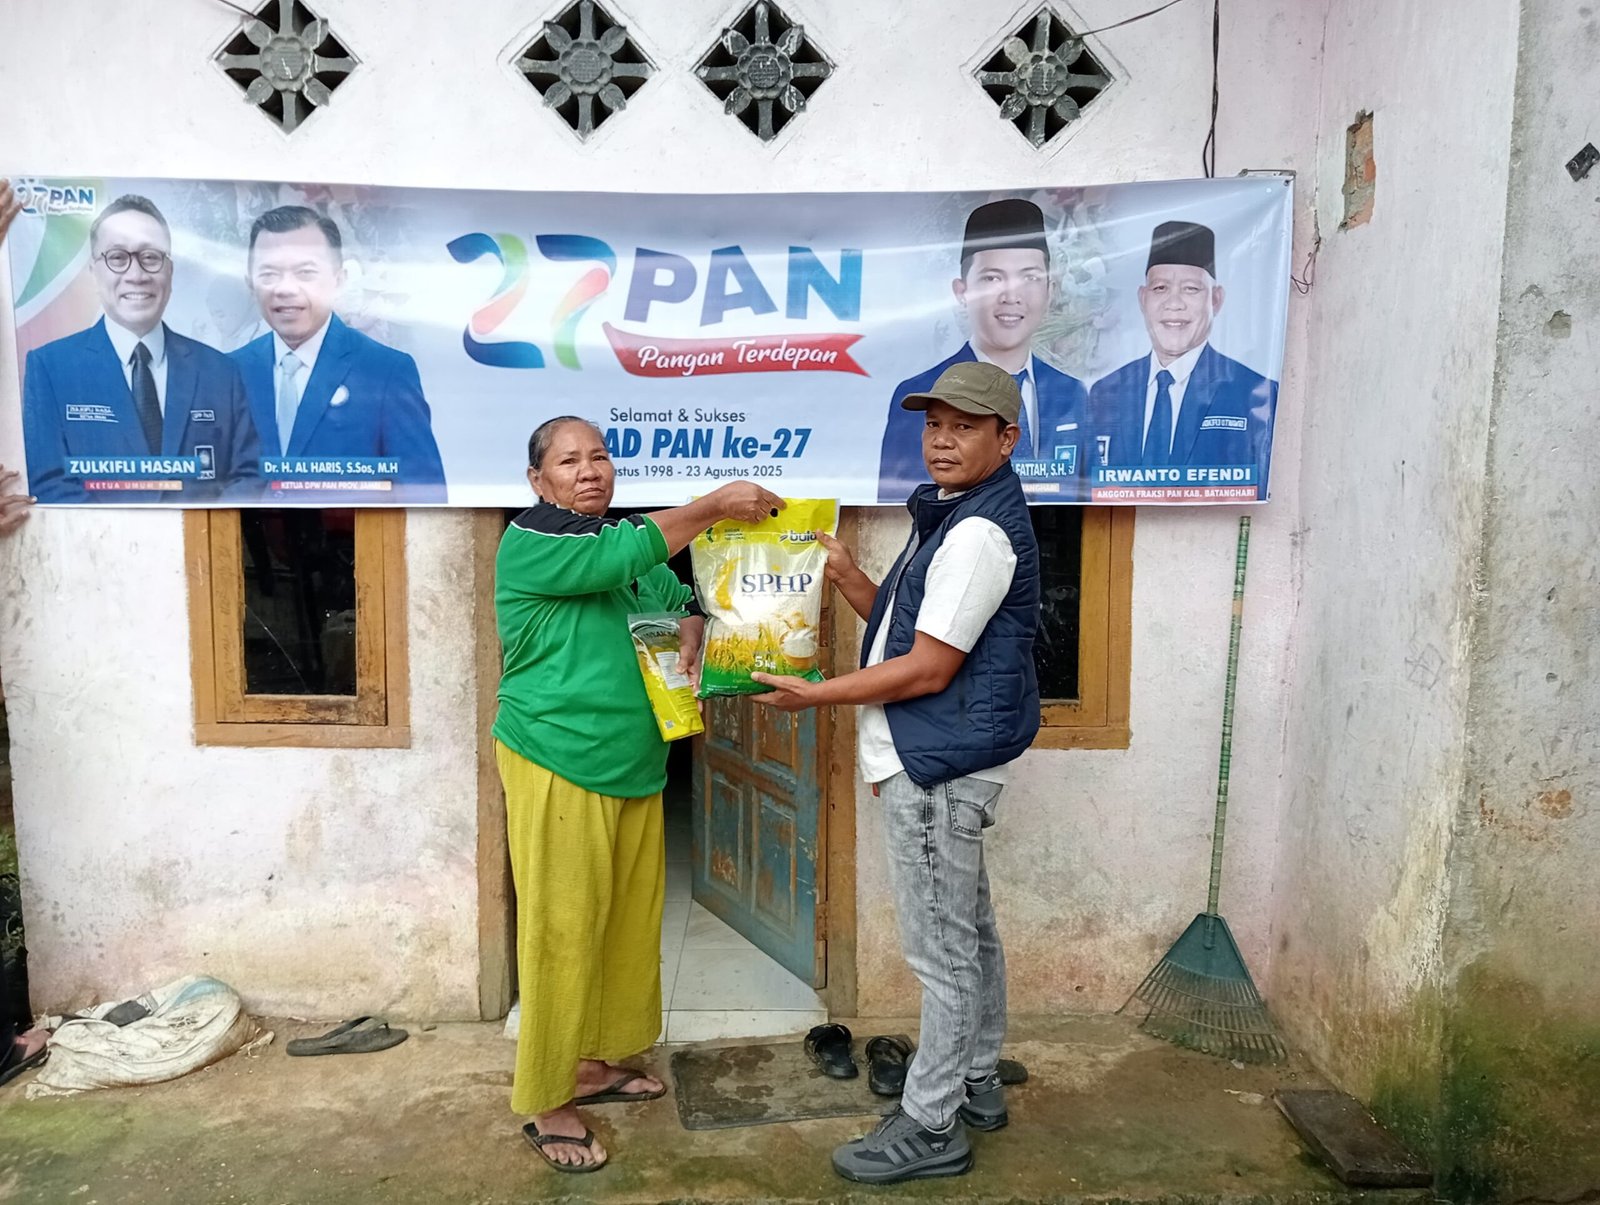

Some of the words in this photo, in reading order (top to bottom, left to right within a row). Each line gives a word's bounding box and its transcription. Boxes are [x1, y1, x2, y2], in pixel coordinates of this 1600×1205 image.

[49, 189, 93, 205] PAN
[446, 232, 617, 371] 27
[624, 245, 863, 326] PAN
[637, 345, 724, 376] Pangan
[732, 339, 838, 369] Terdepan
[610, 407, 672, 423] Selamat
[677, 408, 690, 422] &
[694, 408, 746, 423] Sukses
[604, 428, 642, 458] AD
[651, 428, 714, 458] PAN
[721, 426, 812, 459] ke-27
[69, 460, 136, 474] ZULKIFLI
[140, 460, 196, 474] HASAN
[264, 462, 279, 473] Dr.
[281, 462, 293, 473] H.
[295, 462, 308, 473] AL
[310, 462, 345, 475] HARIS,
[346, 462, 376, 475] S.Sos,
[377, 463, 399, 474] M.H
[643, 466, 674, 477] 1998
[686, 466, 700, 477] 23
[704, 466, 750, 479] Agustus
[753, 466, 783, 477] 2025
[1050, 463, 1067, 476] S.H.
[1099, 469, 1180, 482] IRWANTO
[1187, 468, 1250, 481] EFENDI
[89, 482, 121, 490] KETUA
[1136, 489, 1165, 498] FRAKSI
[1166, 489, 1182, 497] PAN
[1183, 489, 1202, 497] KAB.
[1205, 488, 1255, 497] BATANGHARI
[789, 530, 817, 542] bulo
[741, 573, 813, 593] SPHP
[755, 656, 763, 668] 5
